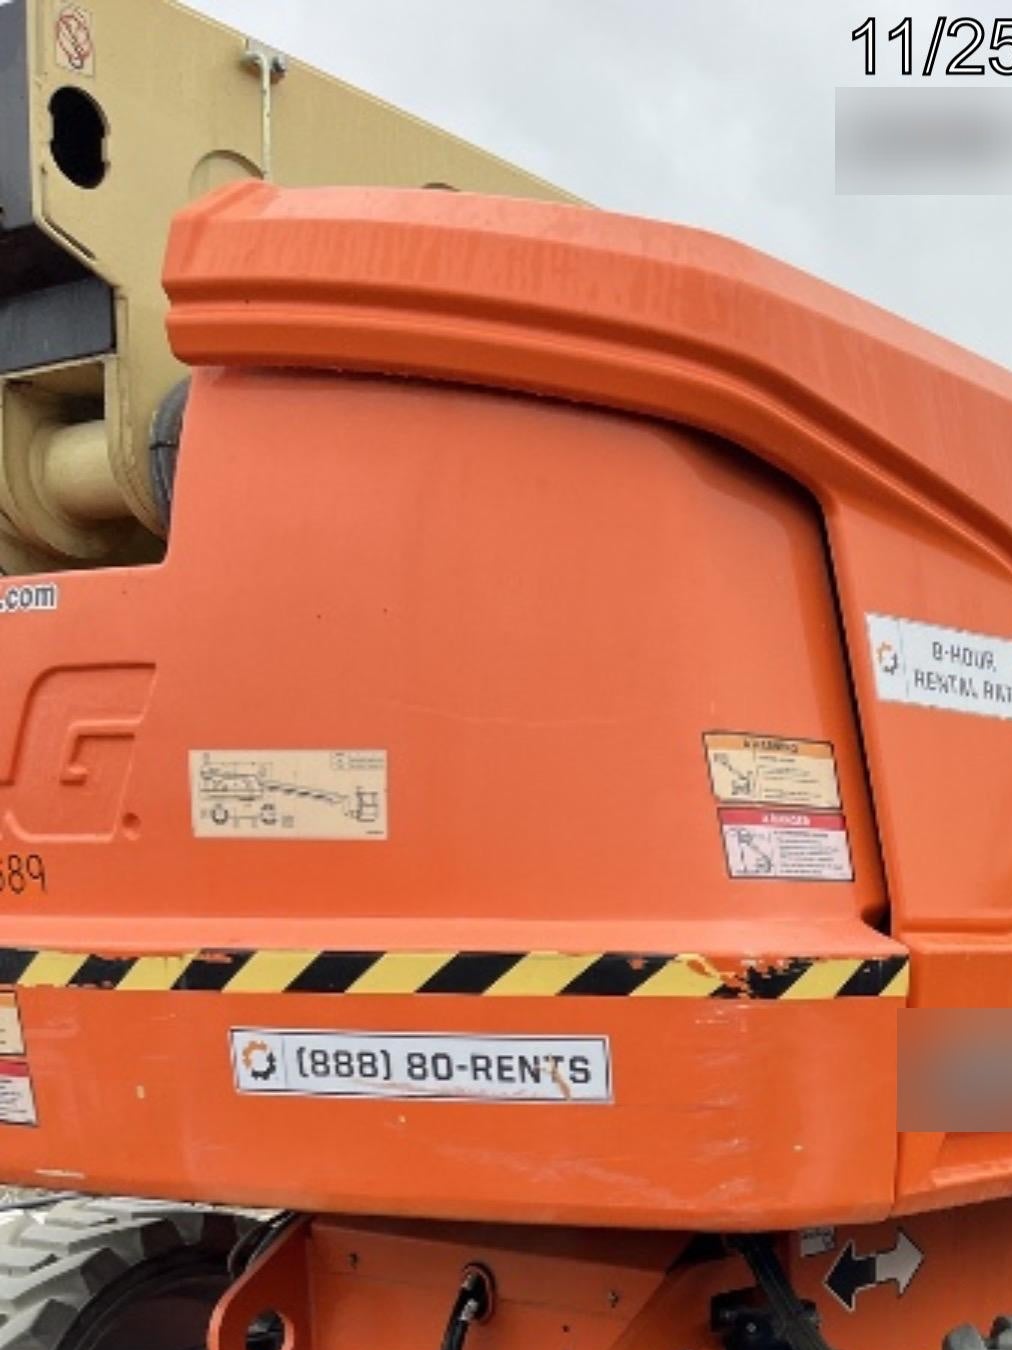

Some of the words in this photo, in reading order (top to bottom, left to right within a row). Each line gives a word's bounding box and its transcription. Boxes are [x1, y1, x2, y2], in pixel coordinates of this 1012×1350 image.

[914, 669, 979, 699] RENTAL
[296, 1046, 393, 1080] (888)
[406, 1051, 592, 1084] 80-RENTS
